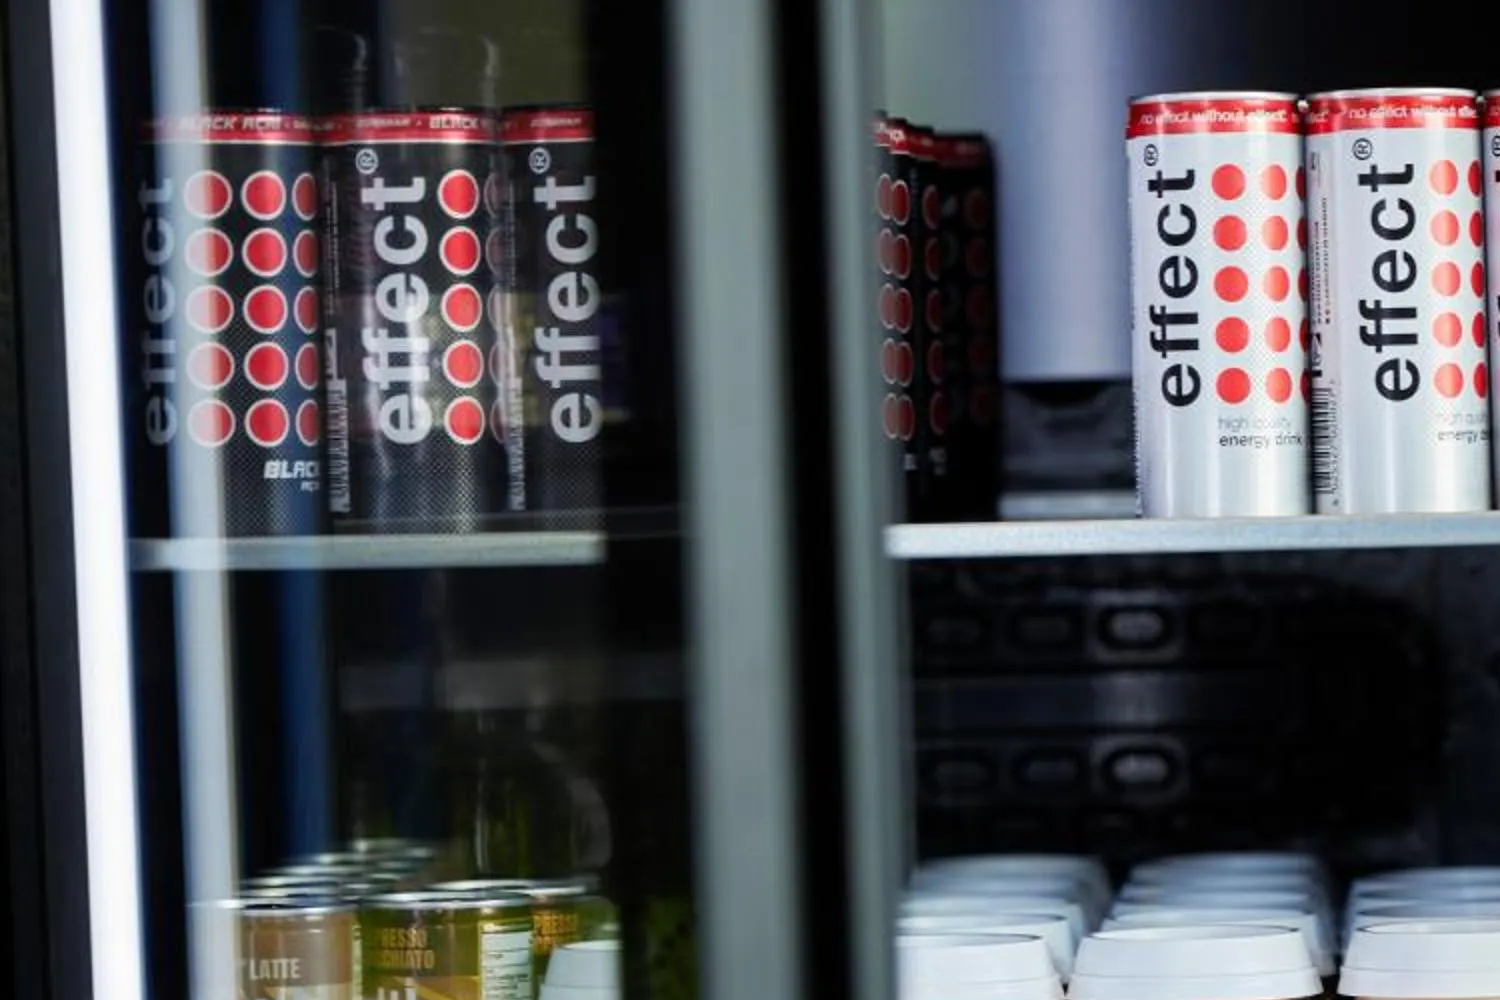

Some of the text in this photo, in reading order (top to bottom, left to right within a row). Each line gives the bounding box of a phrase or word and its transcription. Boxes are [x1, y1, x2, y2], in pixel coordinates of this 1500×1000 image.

[1218, 434, 1270, 449] energy
[263, 459, 319, 479] BLAC
[249, 957, 302, 981] LATTE
